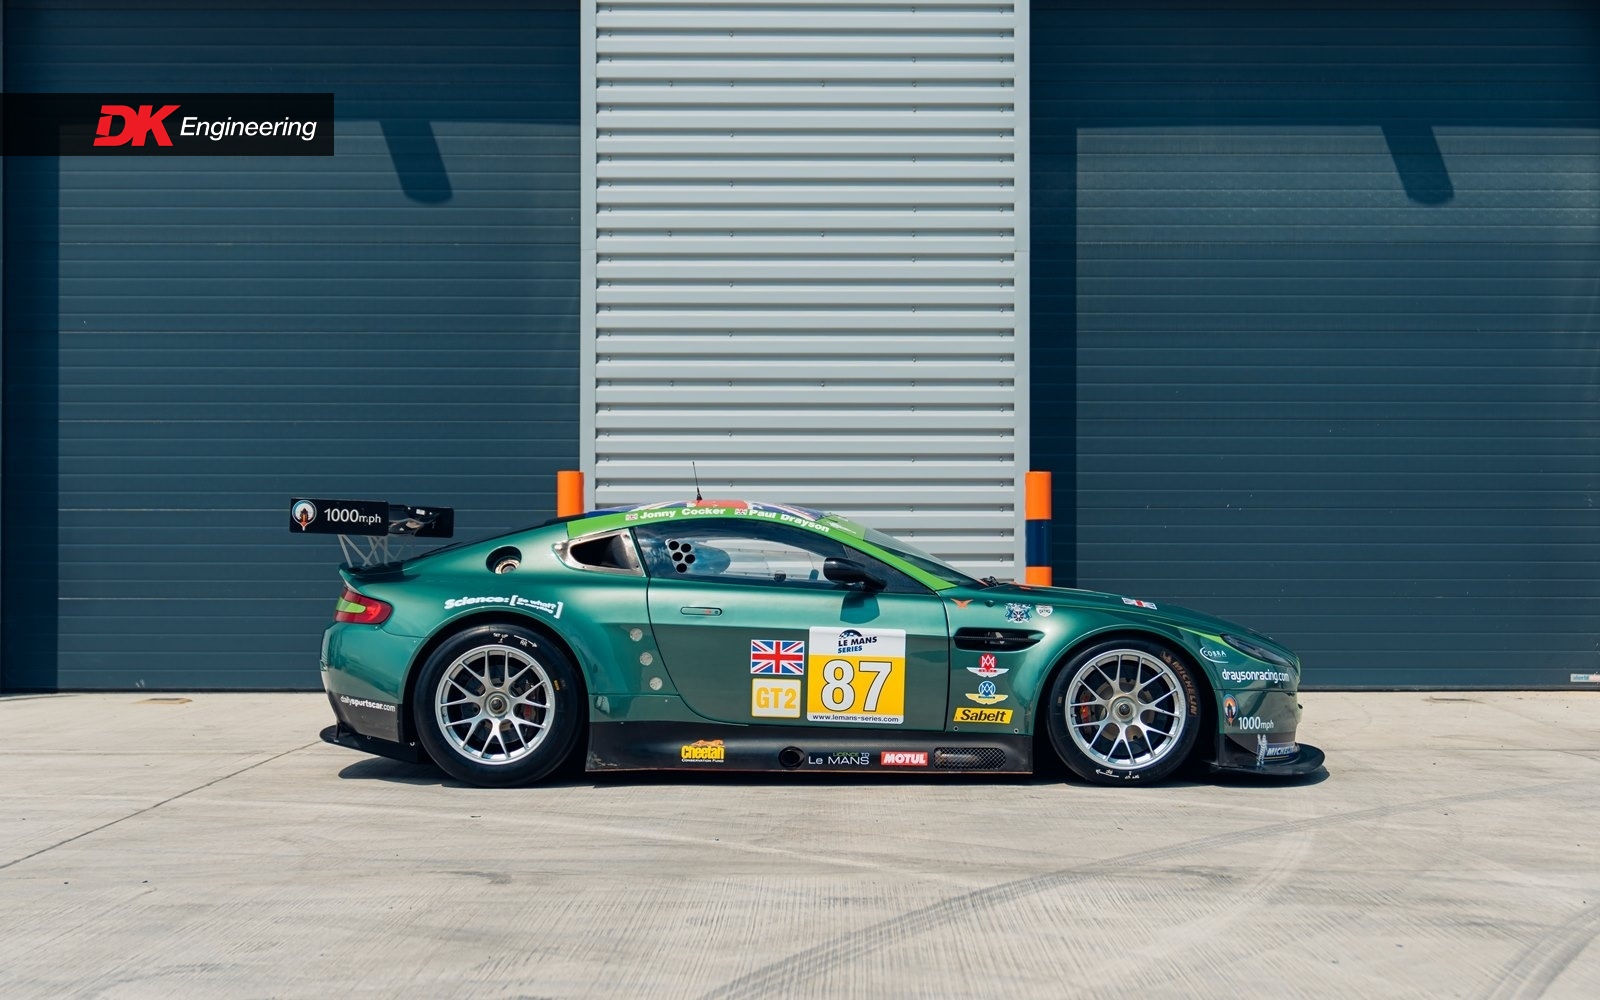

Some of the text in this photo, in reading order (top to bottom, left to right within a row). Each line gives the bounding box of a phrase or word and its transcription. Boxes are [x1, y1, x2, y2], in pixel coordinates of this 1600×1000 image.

[324, 508, 382, 526] 1000mph
[640, 508, 726, 519] Jonny Cocker
[749, 509, 777, 519] Paul
[780, 514, 830, 533] Drayson
[851, 636, 878, 646] MANS
[837, 645, 863, 654] SERIES
[1203, 650, 1227, 658] COBRA
[1222, 668, 1290, 684] draysonracing.com
[821, 659, 892, 712] 87
[1172, 661, 1197, 715] MICHELIN
[340, 695, 396, 712] dailysportscar.com
[756, 687, 797, 710] GT2
[812, 714, 899, 723] www.lemans-series.com
[960, 709, 1006, 722] Sabelt
[1238, 716, 1275, 731] 1000mph
[681, 745, 725, 759] Cheetah
[884, 753, 926, 764] MOTUL
[808, 756, 870, 765] Le MANS
